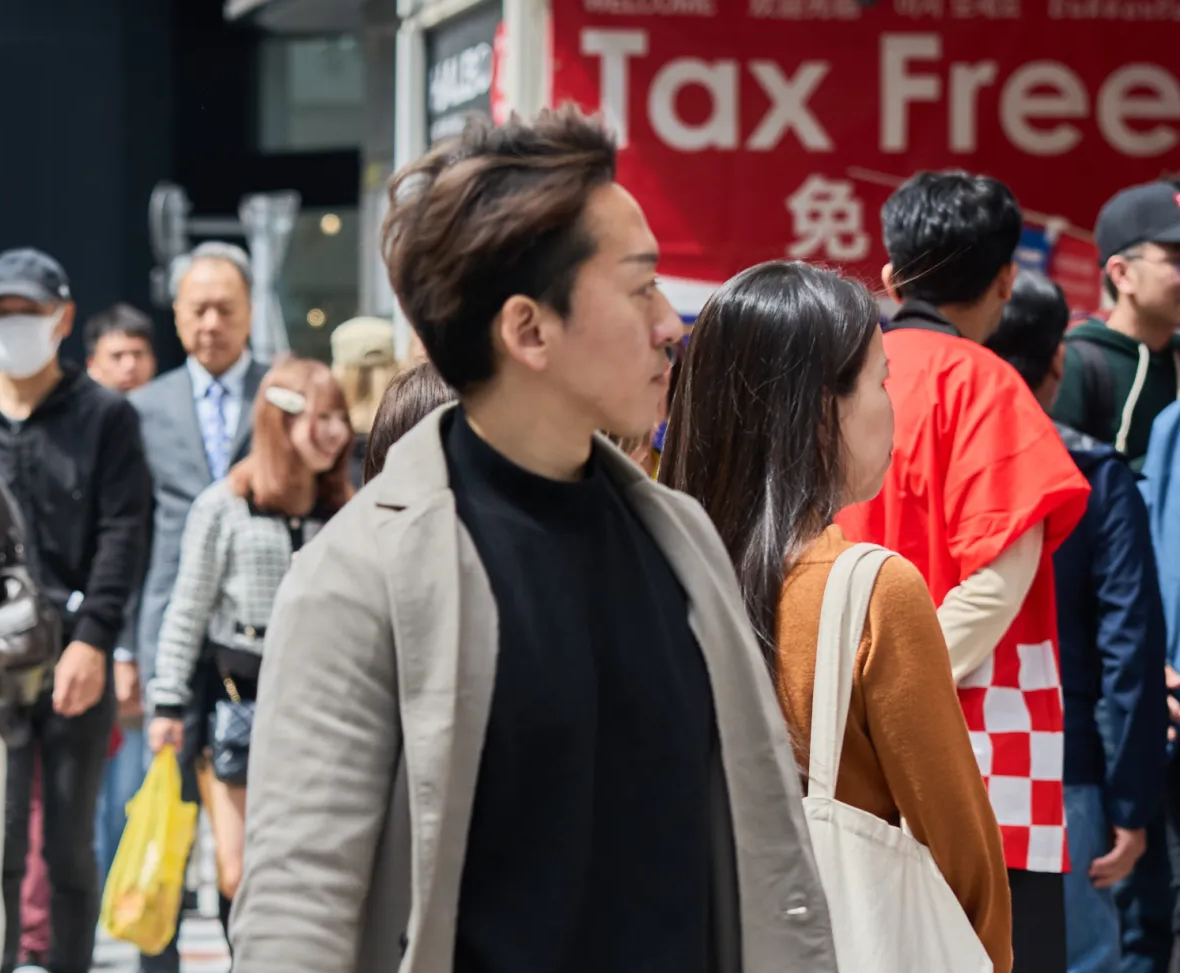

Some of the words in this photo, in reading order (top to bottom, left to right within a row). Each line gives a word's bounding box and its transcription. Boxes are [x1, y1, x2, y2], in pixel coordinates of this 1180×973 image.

[581, 29, 833, 151] Tax
[879, 32, 1180, 156] Free
[786, 174, 869, 259] 免
